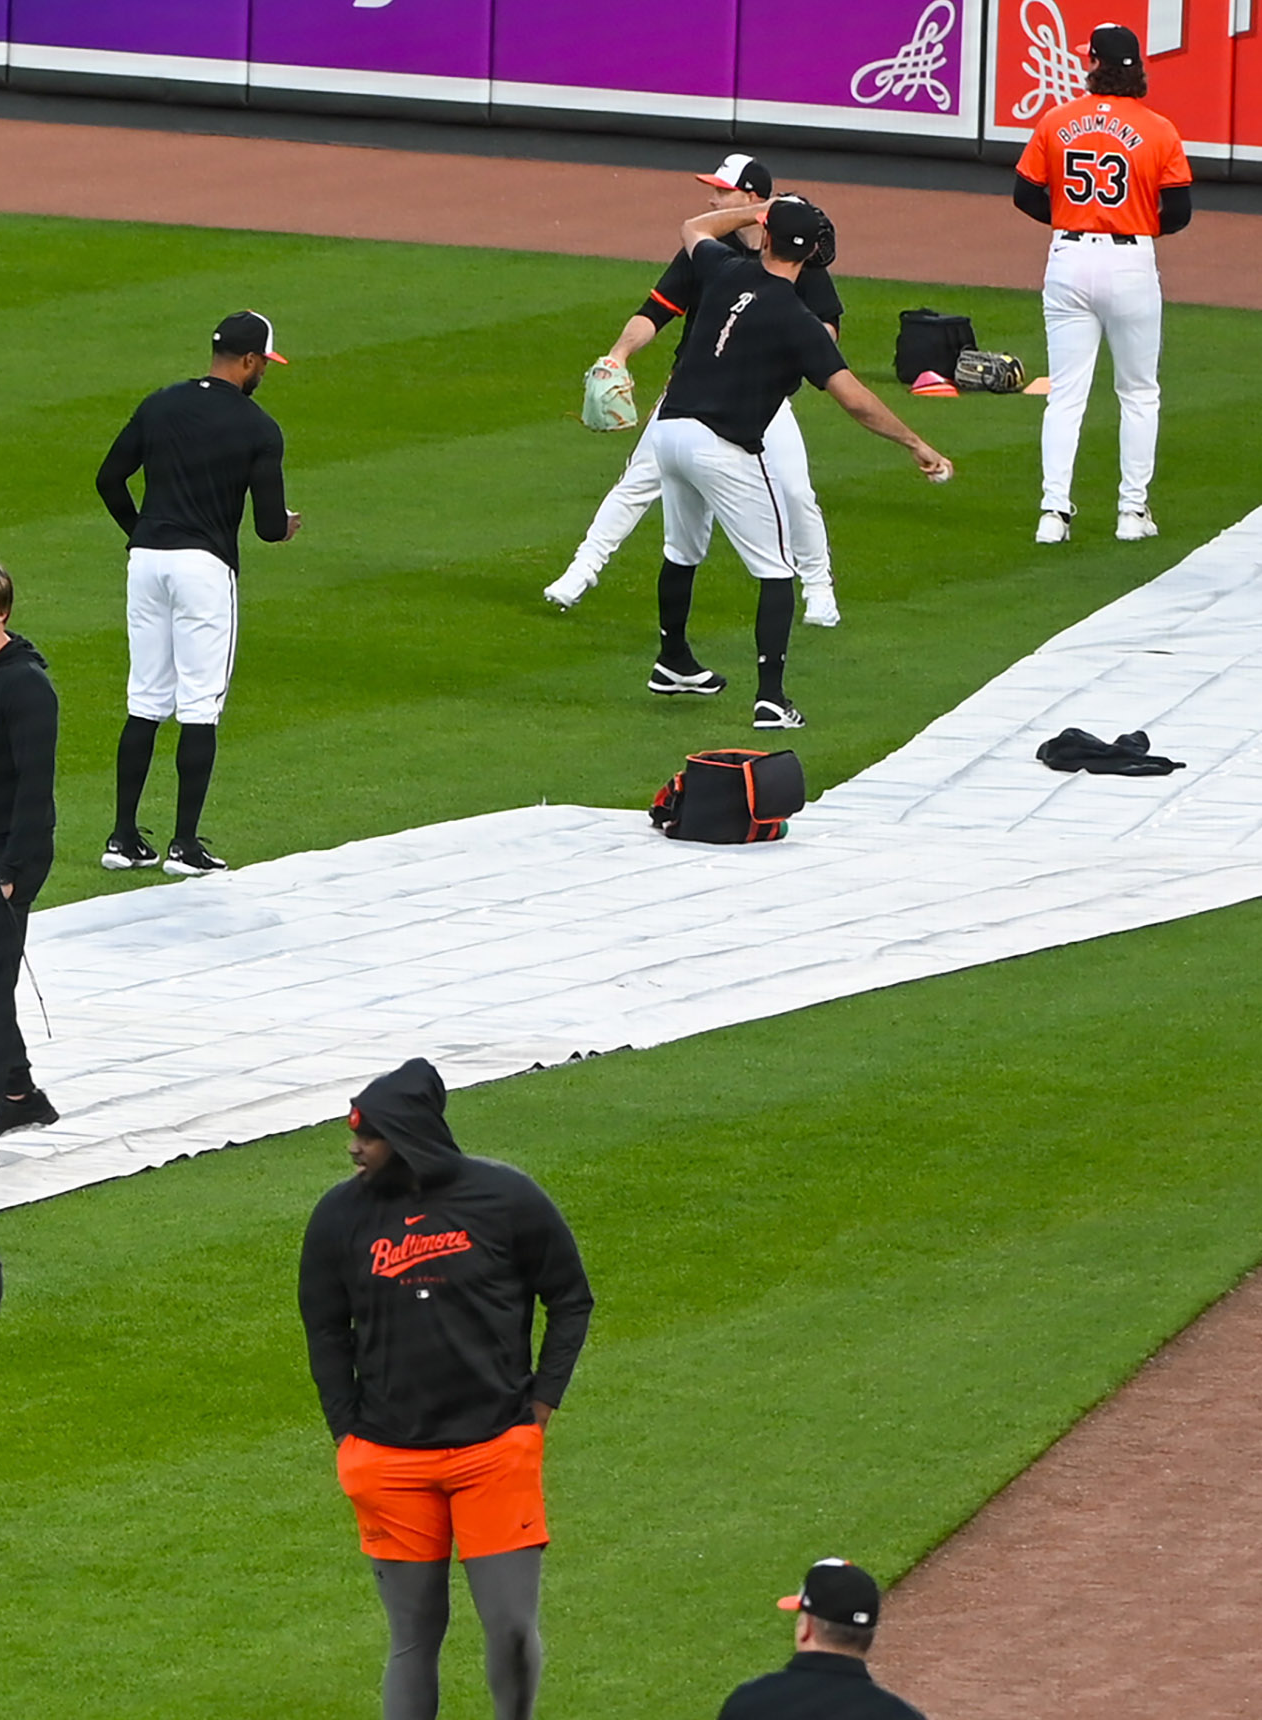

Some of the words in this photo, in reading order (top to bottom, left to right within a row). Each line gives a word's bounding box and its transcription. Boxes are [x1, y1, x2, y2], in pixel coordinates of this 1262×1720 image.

[1057, 115, 1144, 151] BAUMANN
[1064, 149, 1130, 208] 53
[370, 1230, 472, 1277] Baltimore
